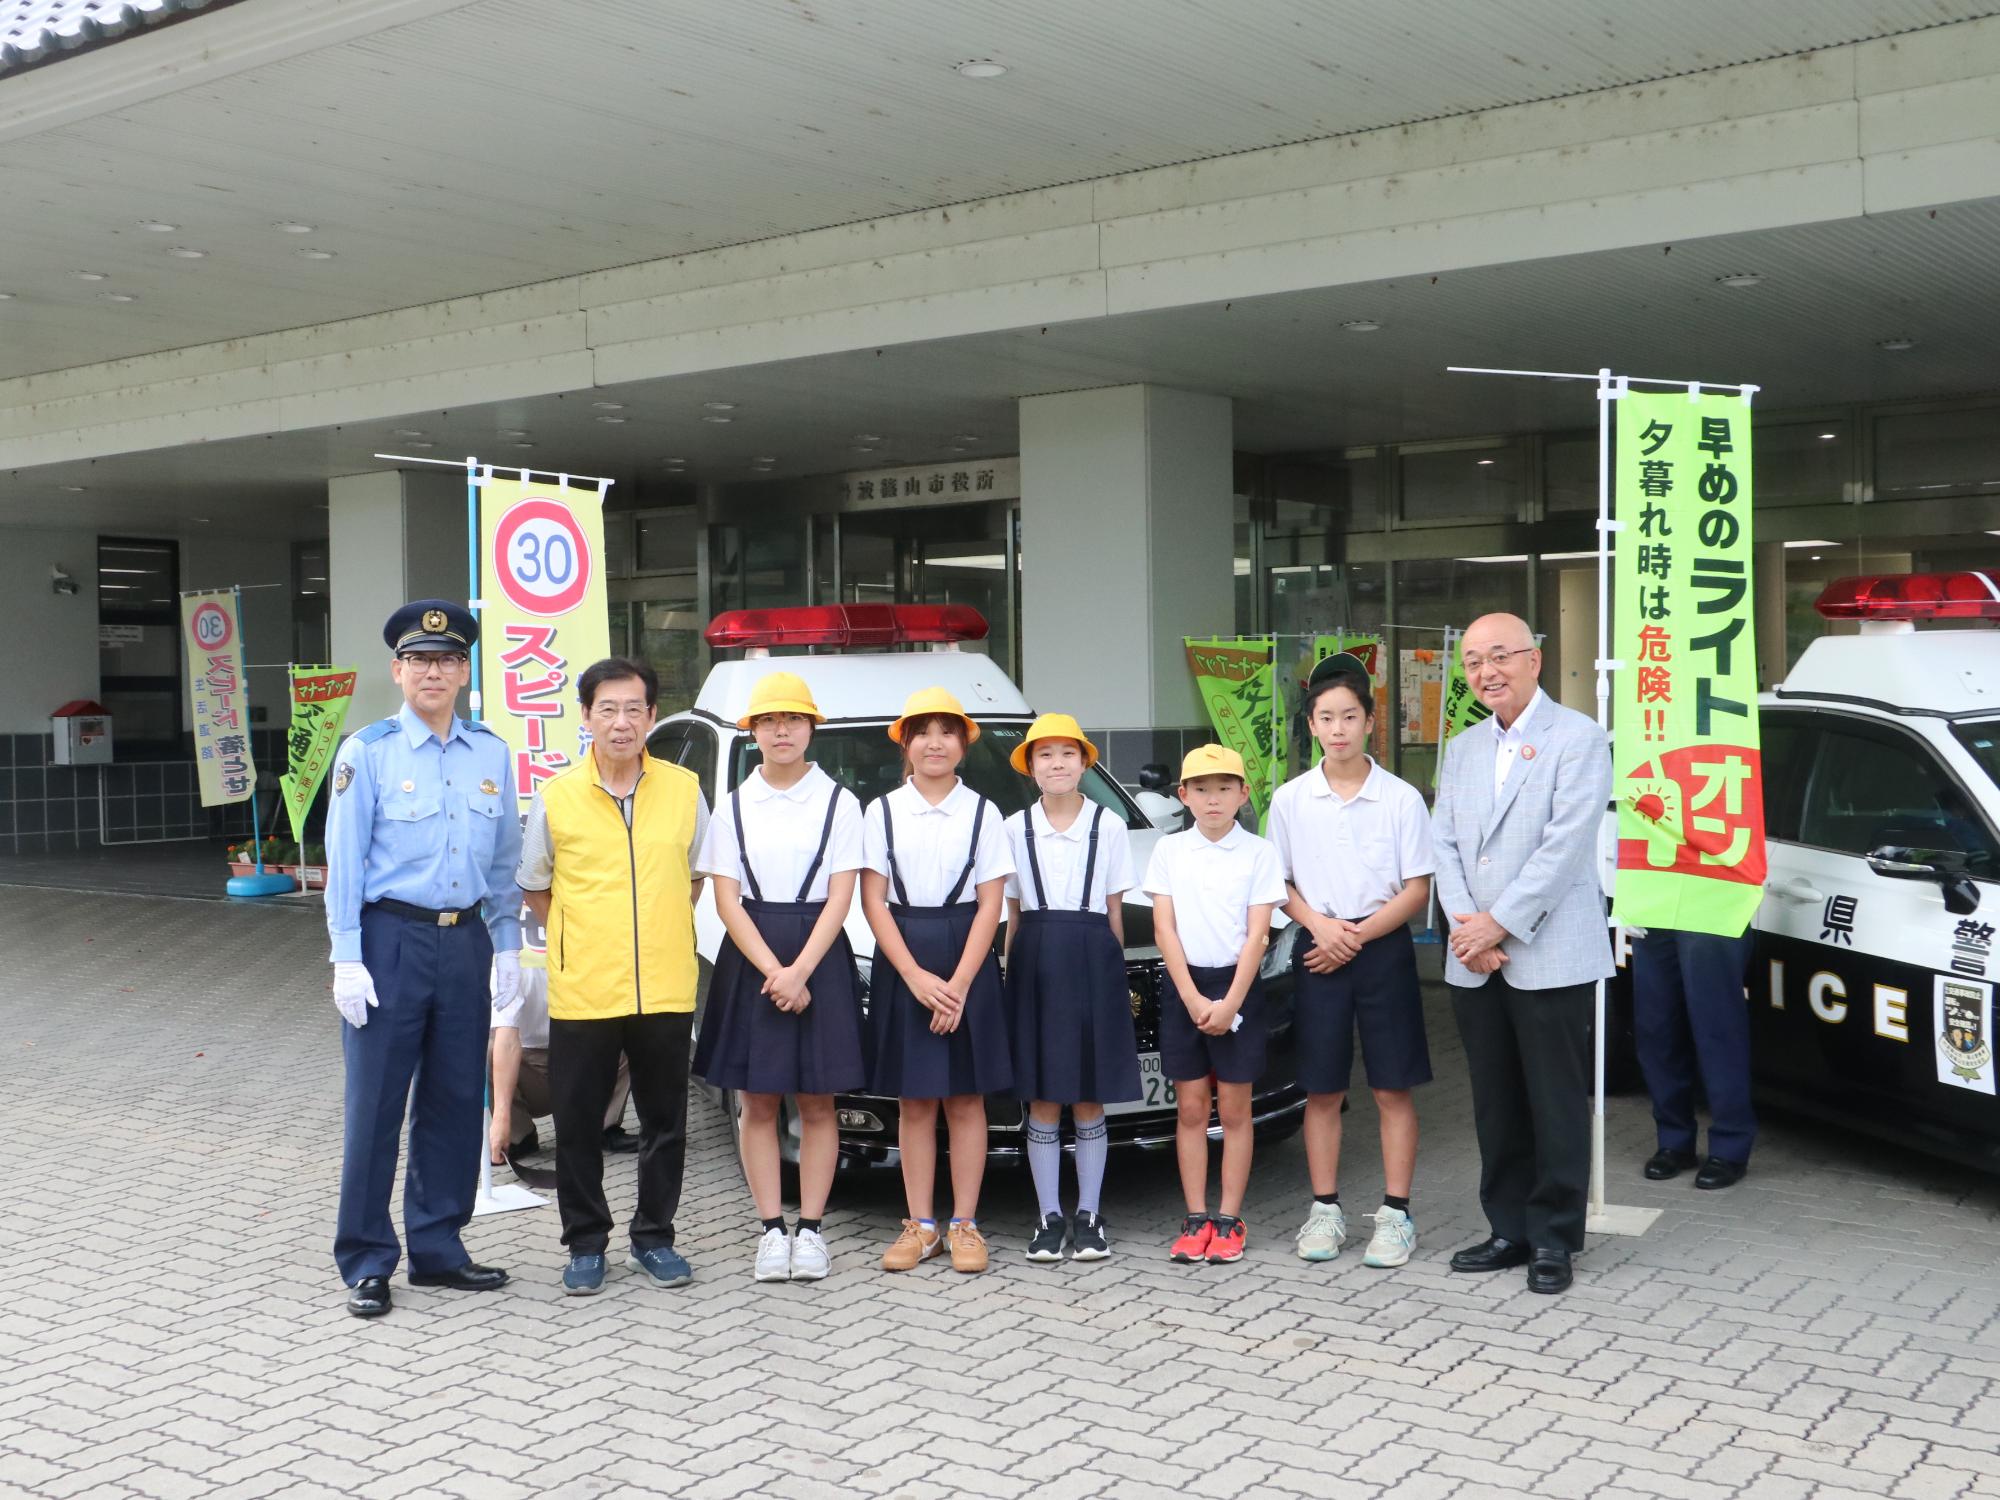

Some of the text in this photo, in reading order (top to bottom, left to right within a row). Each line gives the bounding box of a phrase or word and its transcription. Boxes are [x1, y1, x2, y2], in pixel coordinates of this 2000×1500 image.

[516, 531, 573, 585] 30
[298, 674, 355, 699] マナーアップ
